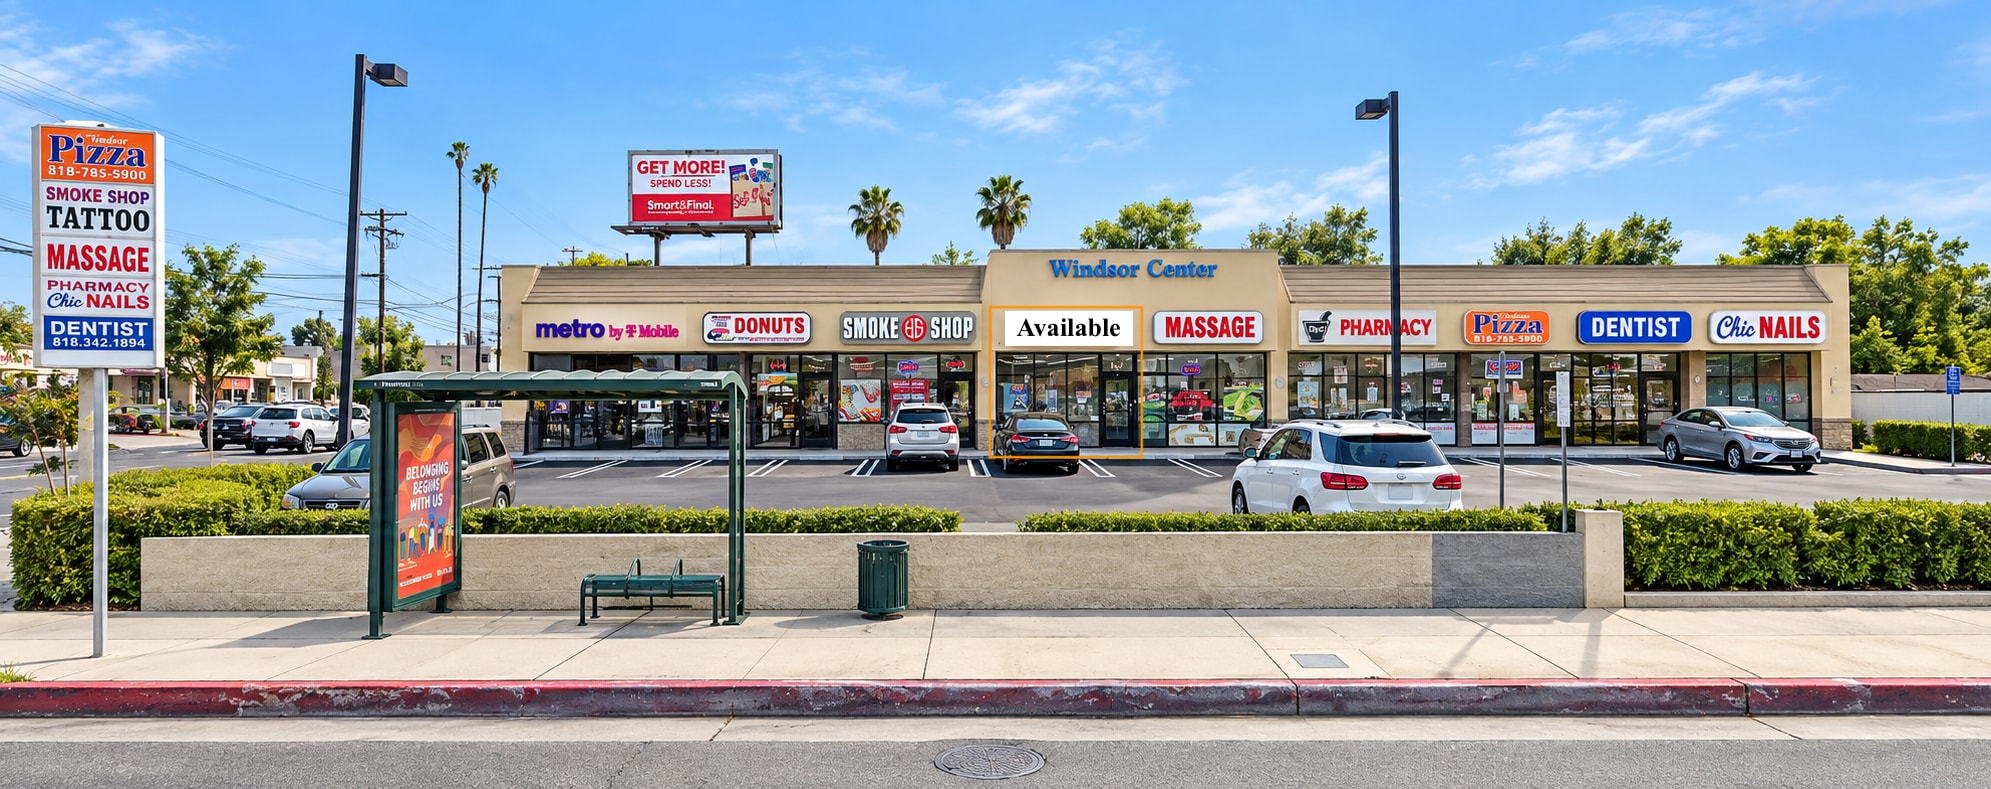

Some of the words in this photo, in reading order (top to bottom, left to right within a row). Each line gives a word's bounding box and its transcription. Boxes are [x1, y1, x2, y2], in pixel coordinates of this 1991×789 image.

[48, 134, 147, 167] Pizza
[637, 160, 669, 175] GET
[673, 160, 725, 174] MORE!
[650, 179, 682, 188] SPEND
[684, 179, 711, 188] LESS!
[46, 186, 102, 203] SMOKE
[108, 190, 149, 205] SHOP
[46, 205, 150, 232] TATTOO
[47, 243, 149, 273] MASSAGE
[1049, 259, 1140, 279] Windsor
[1147, 259, 1217, 279] Center
[47, 280, 149, 293] PHARMACY
[47, 292, 84, 309] Chic
[86, 293, 149, 310] NAILS
[50, 321, 148, 336] DENTIST
[535, 319, 605, 338] metro
[608, 324, 623, 341] by
[638, 324, 679, 338] Mobile
[734, 317, 805, 334] DONUTS
[843, 316, 899, 339] SMOKE
[930, 316, 973, 339] SHOP
[1165, 316, 1255, 339] MASSAGE
[1472, 313, 1544, 334] Pizza
[1592, 317, 1680, 337] DENTIST
[1716, 315, 1756, 339] Chic
[1759, 316, 1820, 339] NAILS
[52, 337, 146, 348] 818.342.1894
[405, 461, 449, 480] BELONGING
[413, 477, 440, 496] BEGINS
[410, 496, 430, 511] WITH
[432, 493, 443, 507] US
